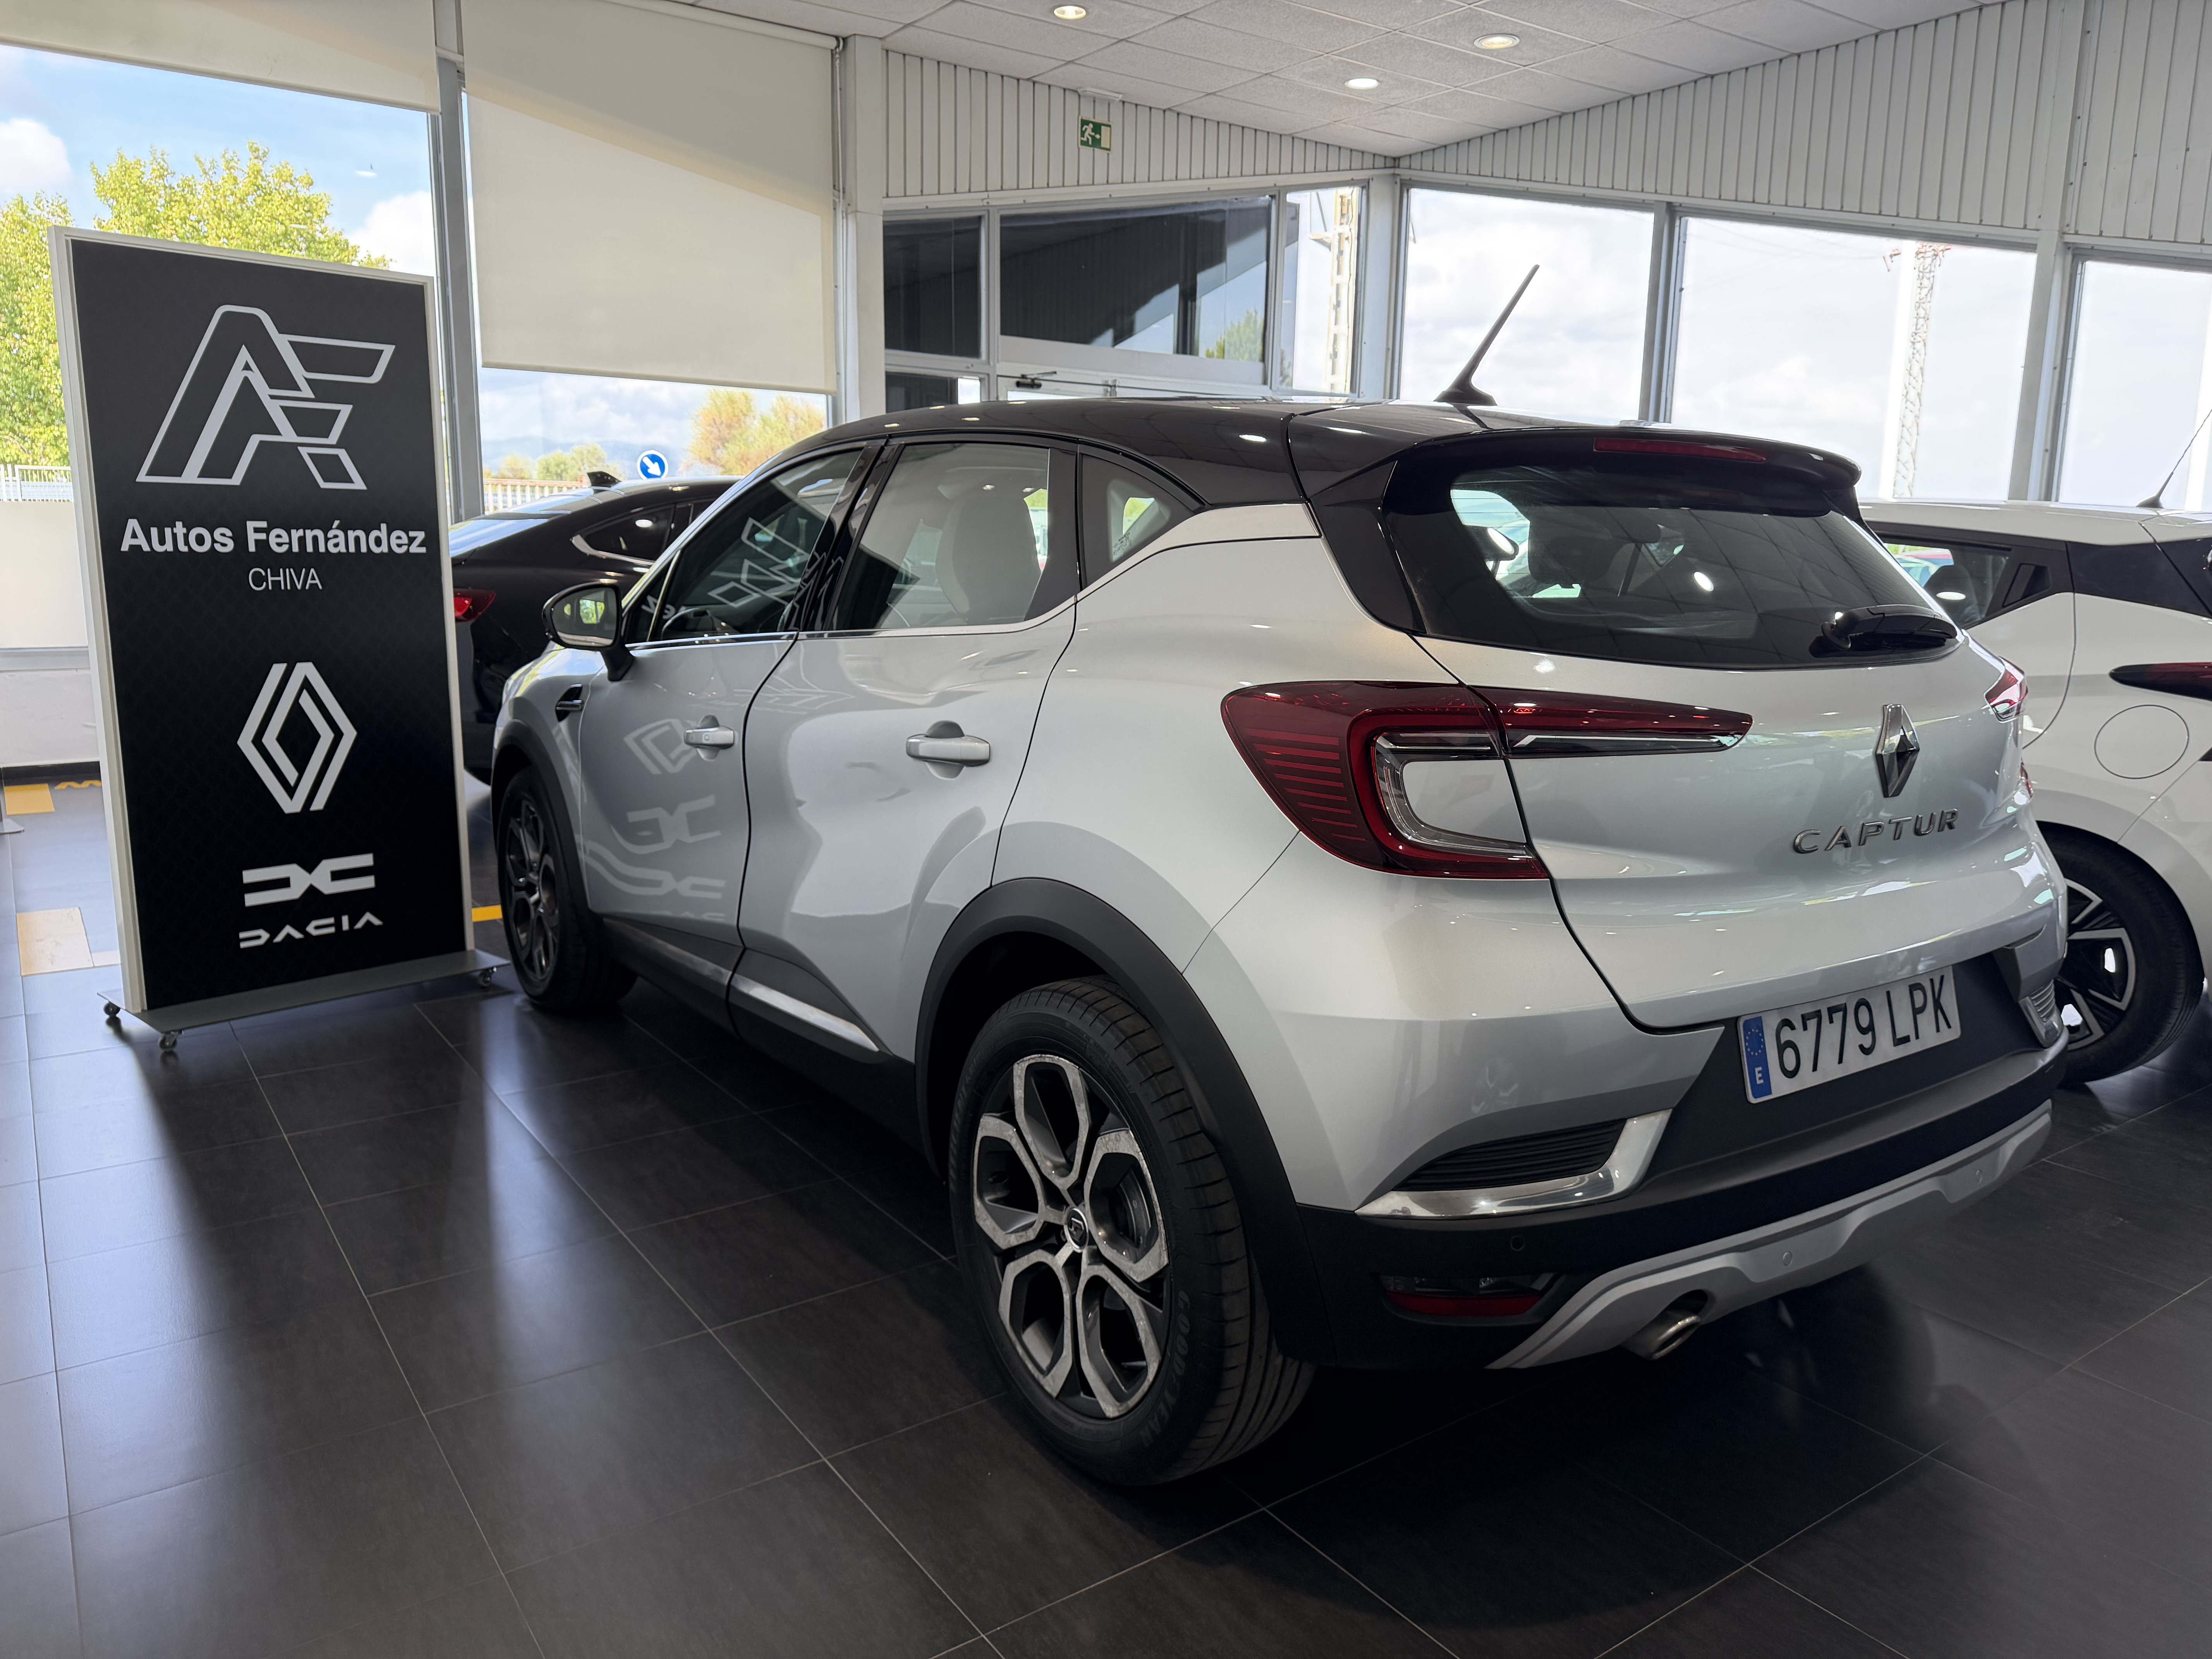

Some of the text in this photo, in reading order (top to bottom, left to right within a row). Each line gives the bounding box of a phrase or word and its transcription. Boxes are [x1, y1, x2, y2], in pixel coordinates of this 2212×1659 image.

[120, 518, 427, 554] Autos Fernández
[248, 567, 323, 591] CHIVA
[1793, 808, 1958, 854] CAPTUR
[239, 911, 383, 949] DACIA
[1775, 974, 1952, 1079] 6779 LPK
[1755, 1066, 1764, 1084] E
